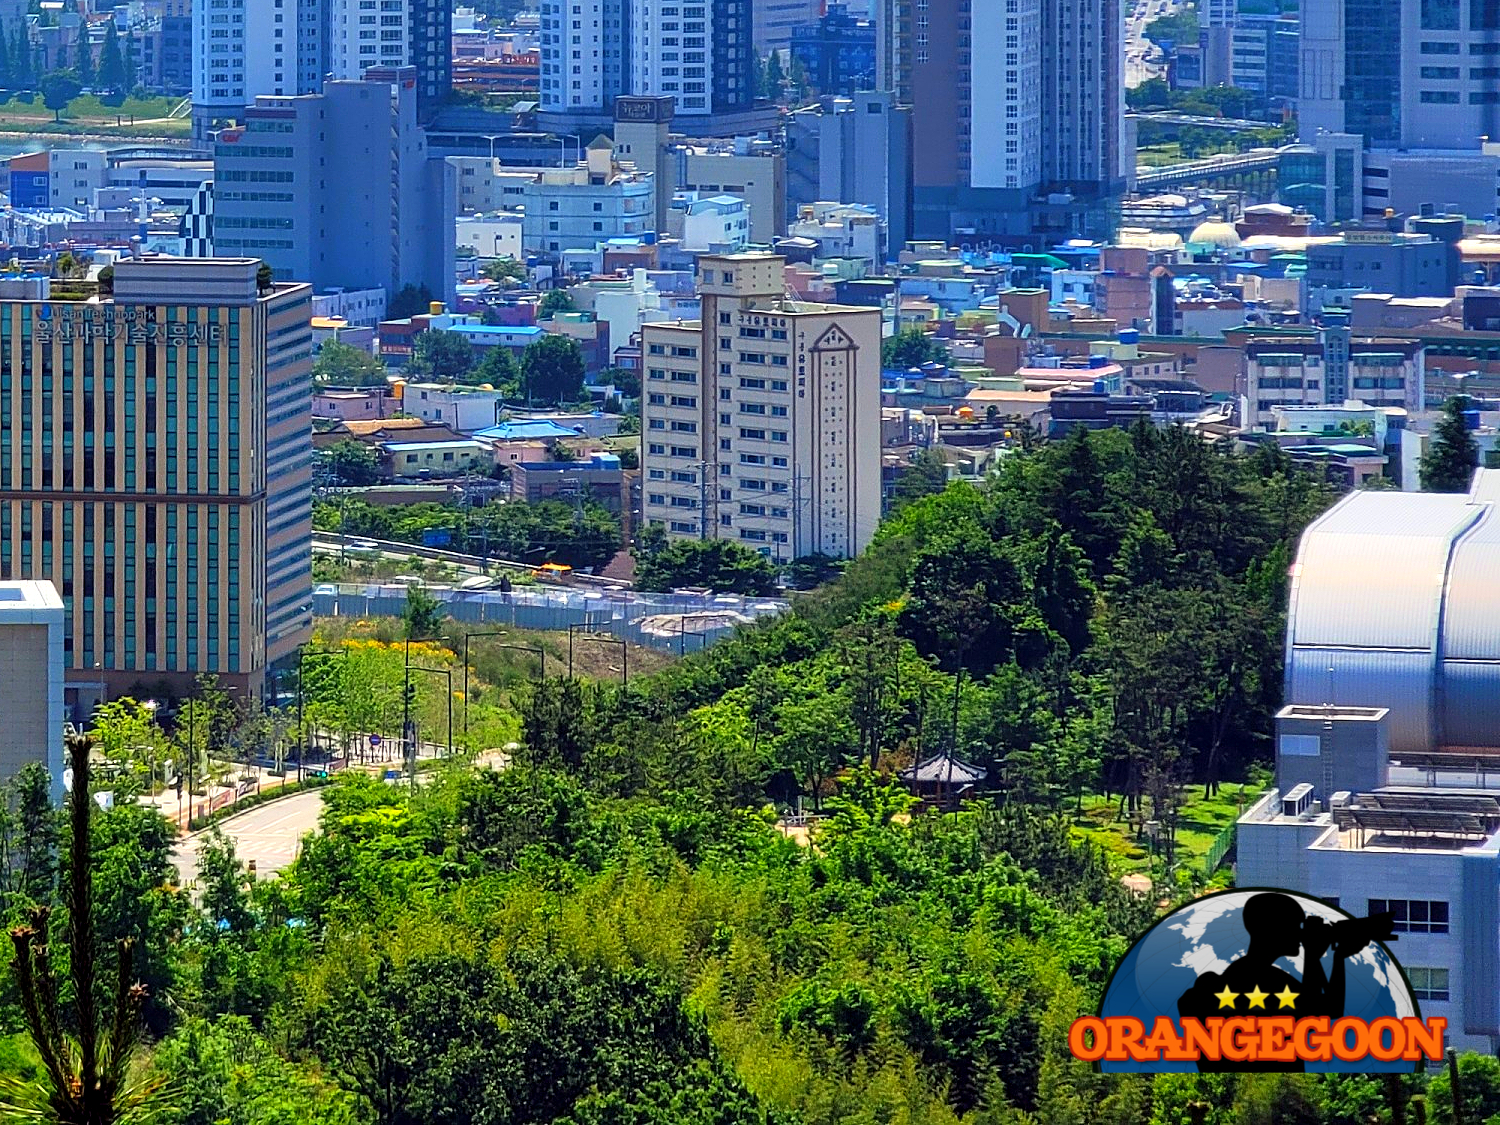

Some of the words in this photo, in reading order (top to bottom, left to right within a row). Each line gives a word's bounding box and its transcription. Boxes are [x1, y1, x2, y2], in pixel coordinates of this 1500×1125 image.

[51, 308, 84, 320] Ulsan
[85, 308, 156, 321] Technopark
[34, 321, 229, 347] 울산과학기술진흥센터
